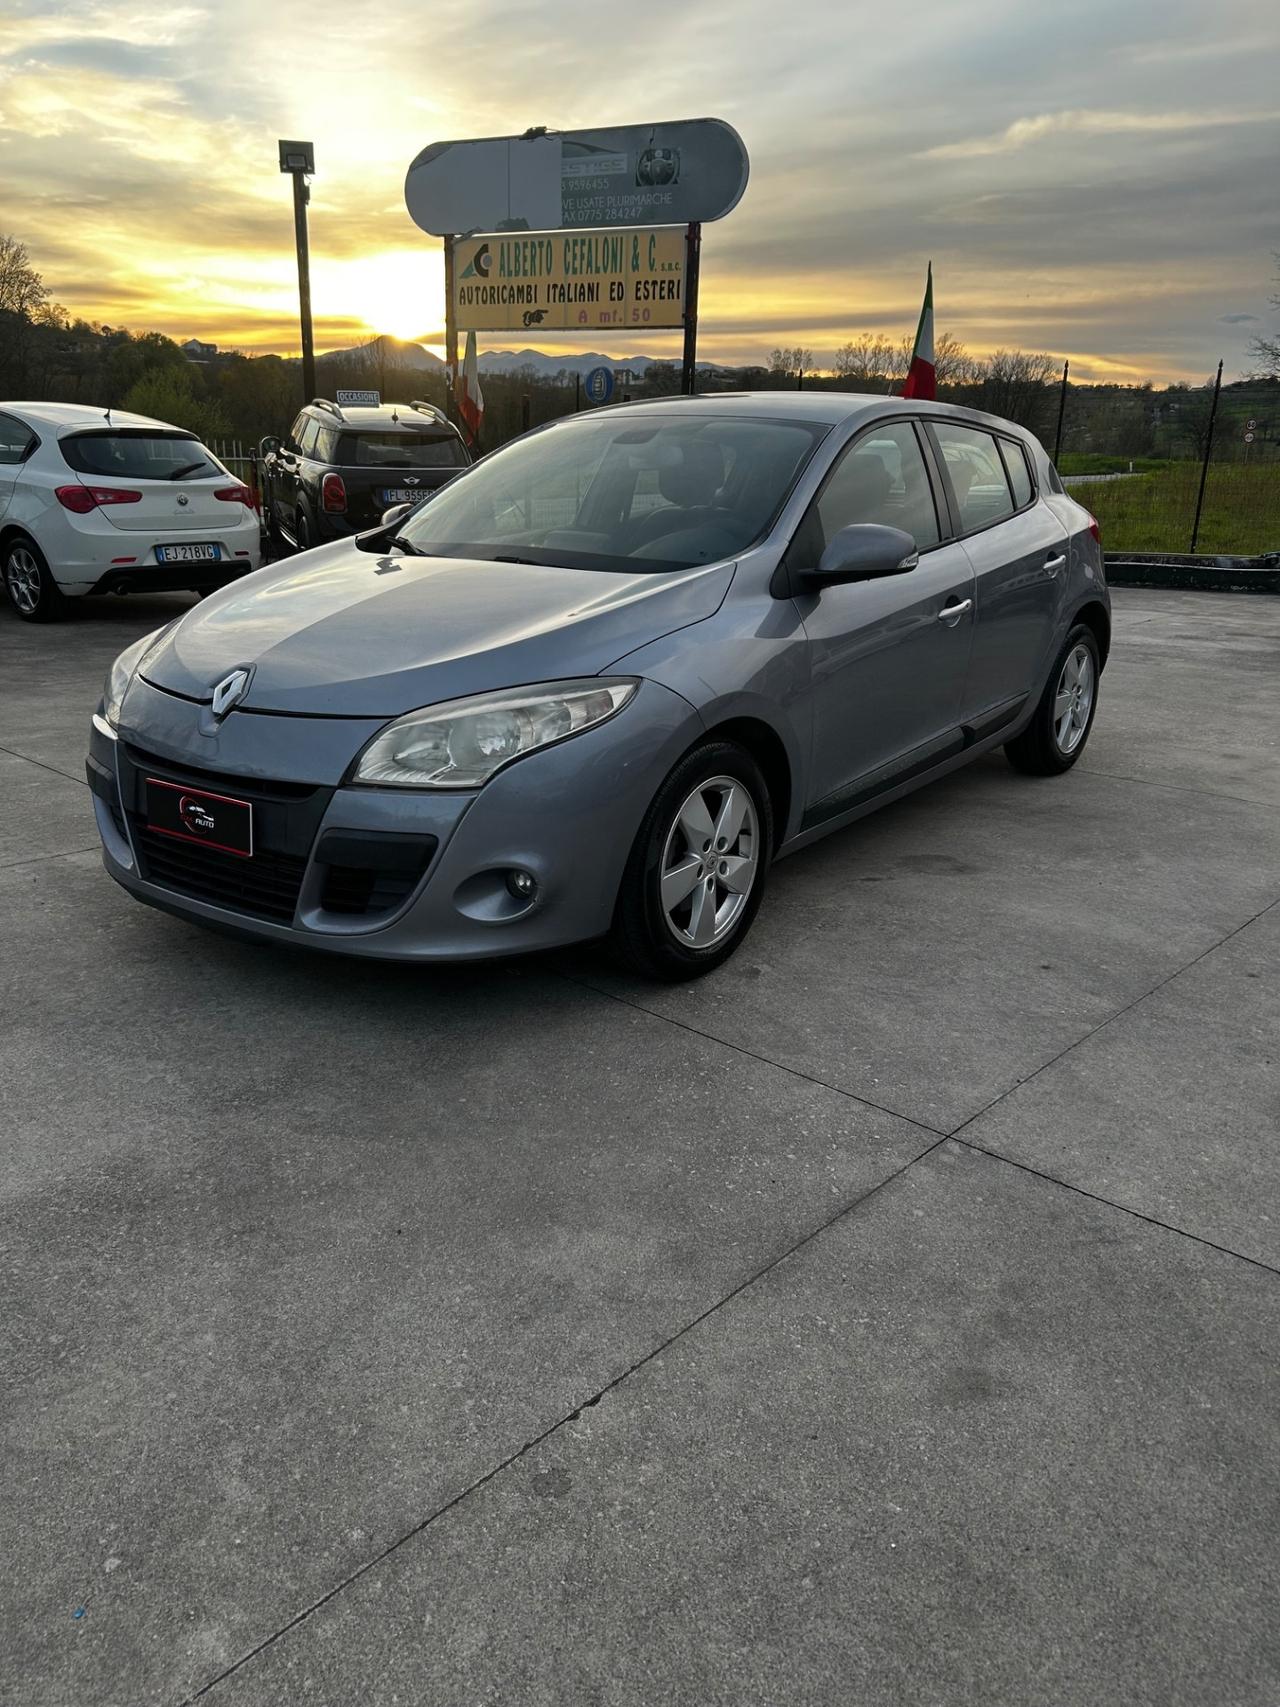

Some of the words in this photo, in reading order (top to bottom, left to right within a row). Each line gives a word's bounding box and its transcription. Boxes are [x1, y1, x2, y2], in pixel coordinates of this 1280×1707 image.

[577, 196, 605, 209] USATE
[606, 192, 673, 208] PLURIMARCHE
[578, 210, 602, 222] 0775
[606, 207, 642, 220] 284247
[499, 239, 553, 278] ALBERTO
[563, 236, 624, 275] CEFALONI
[631, 234, 640, 272] &
[459, 283, 538, 306] AUTORICAMBI
[547, 281, 600, 304] ITALIANI
[609, 281, 625, 302] ED
[635, 279, 681, 301] ESTERI
[578, 309, 588, 323] A
[631, 308, 651, 322] 50
[339, 392, 379, 402] OCCASIONE
[389, 490, 401, 501] FL
[164, 547, 178, 560] EJ
[195, 818, 214, 829] AUTO
